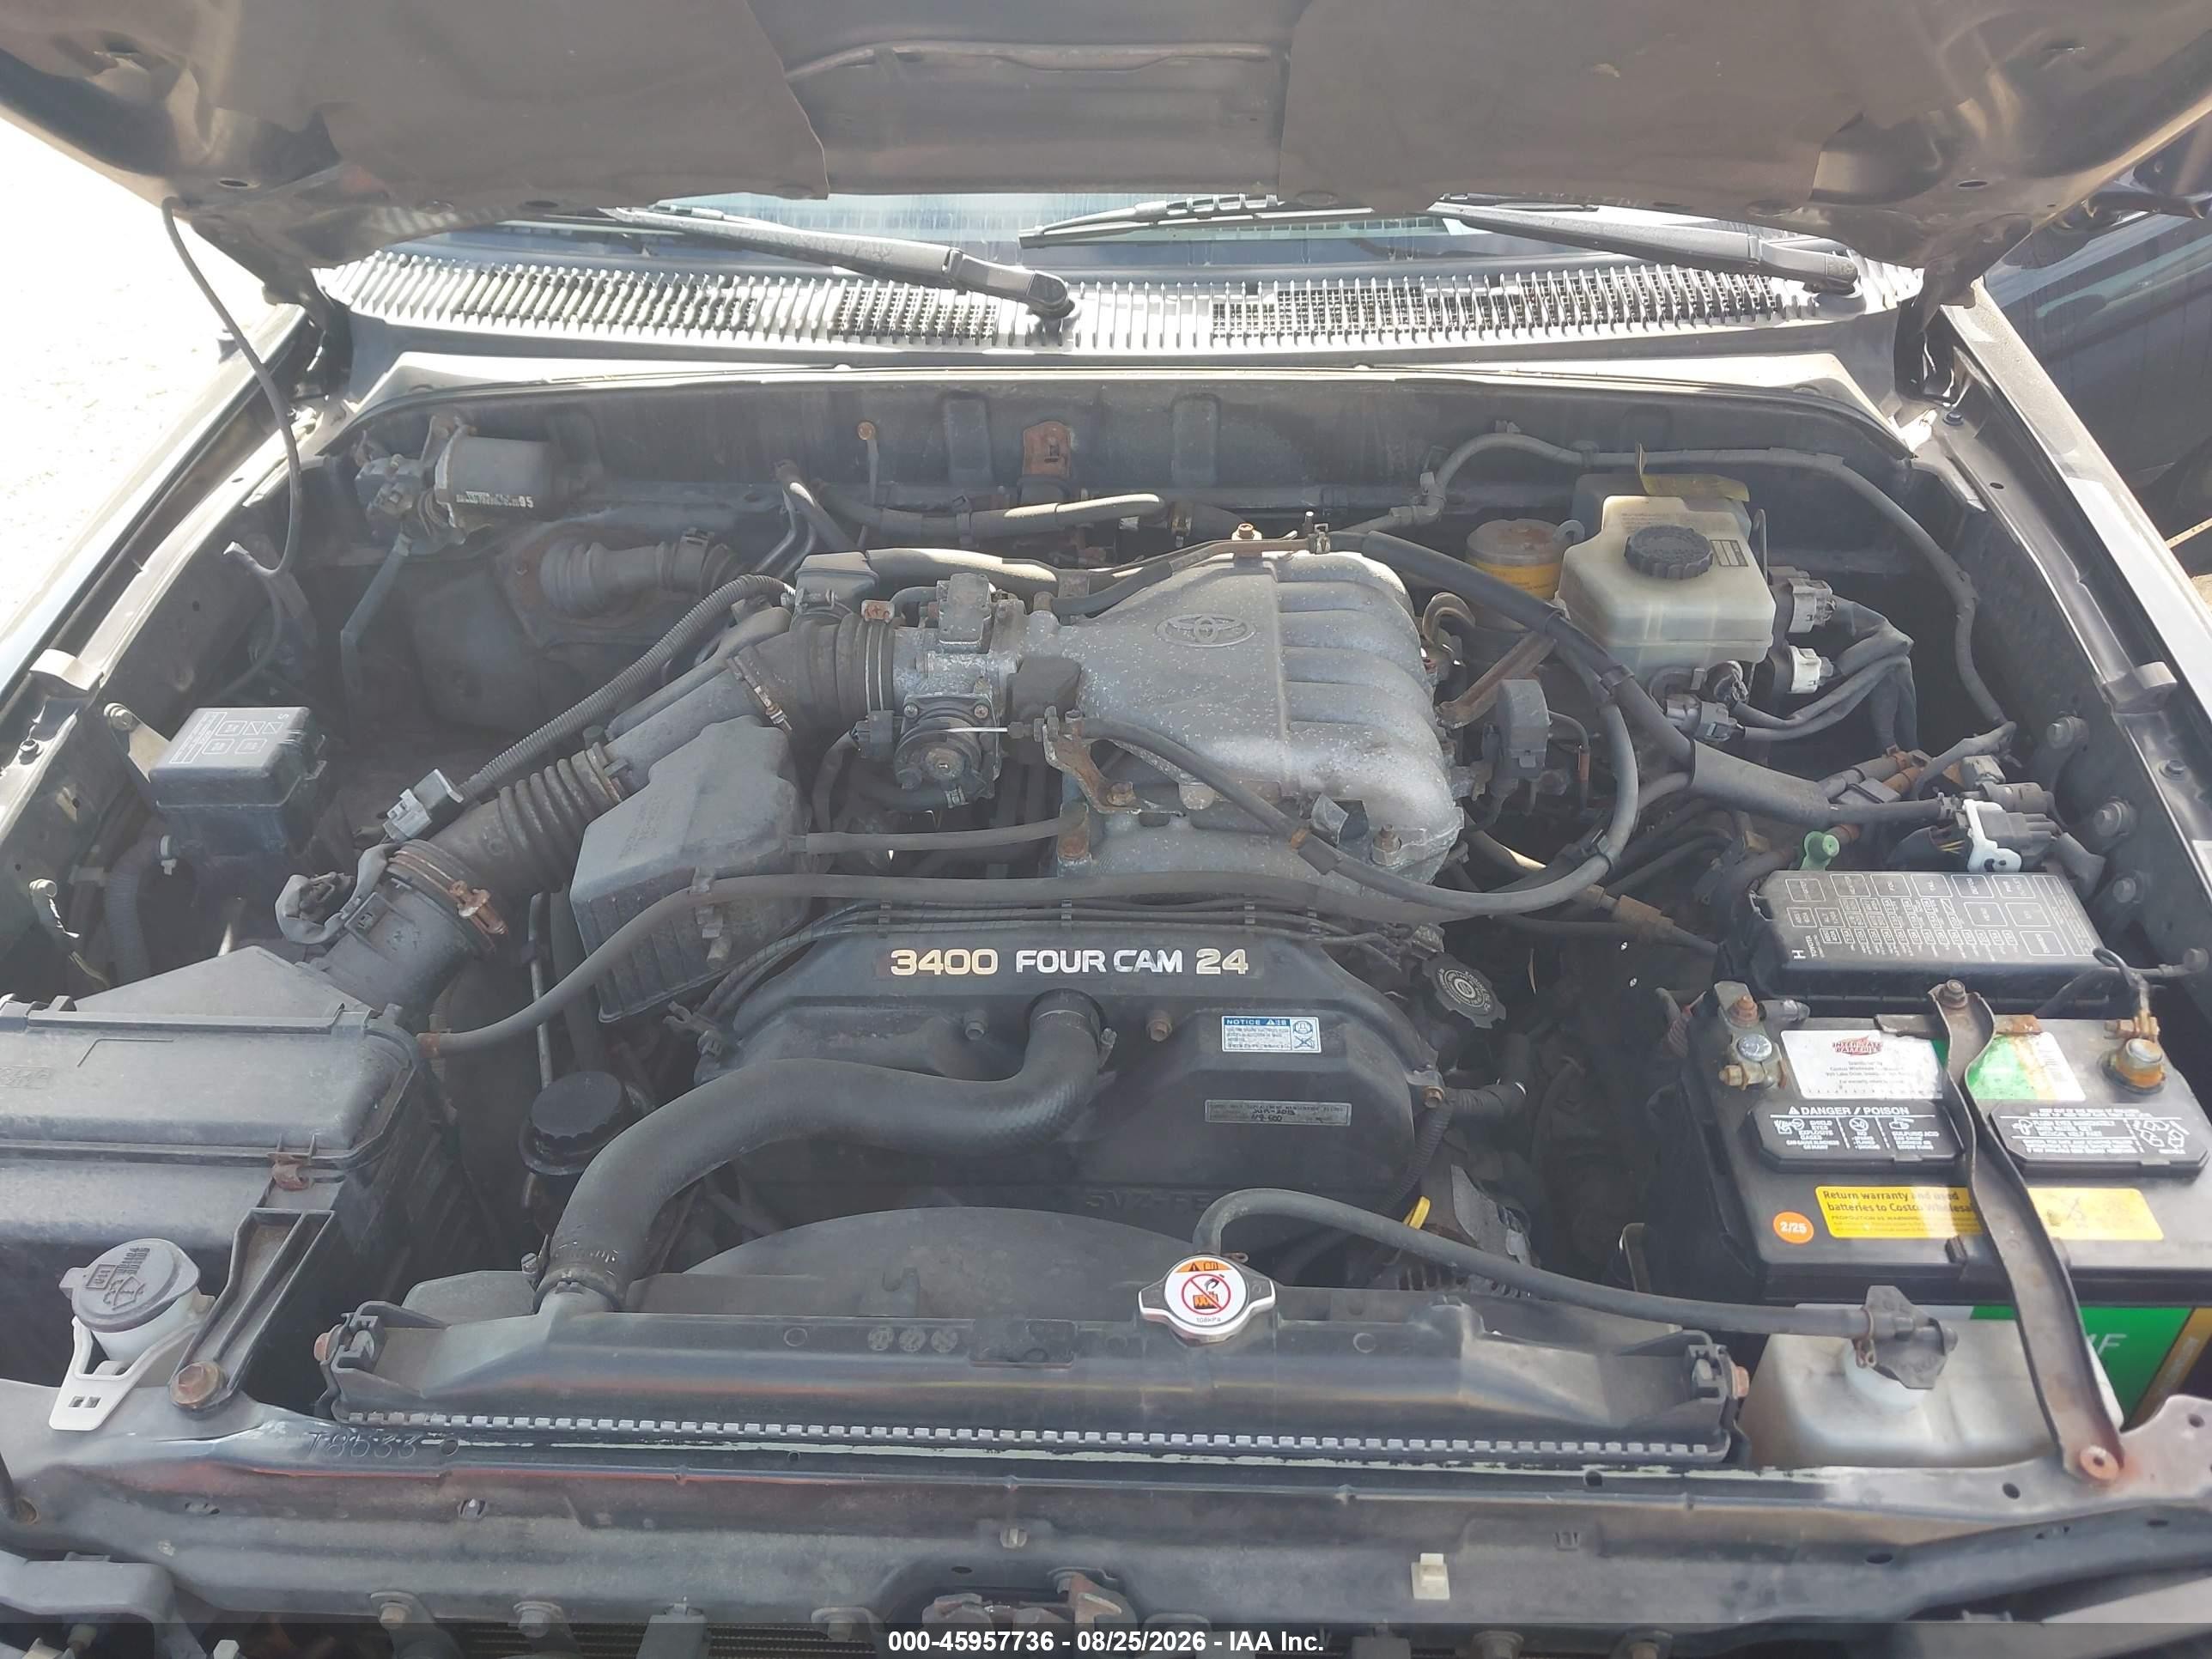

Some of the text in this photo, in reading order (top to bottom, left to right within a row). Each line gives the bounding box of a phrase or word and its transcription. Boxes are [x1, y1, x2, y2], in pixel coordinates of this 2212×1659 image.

[890, 949, 1249, 975] 3400 FOUR CAM 24
[1800, 1106, 1851, 1115] DANGER
[1863, 1106, 1910, 1115] POISON
[1823, 1190, 1859, 1200] Return
[1862, 1191, 1909, 1202] warranty
[1933, 1190, 1960, 1200] used
[1827, 1202, 1875, 1212] batteries
[1876, 1203, 1887, 1212] to
[1889, 1203, 1924, 1213] Costco
[1779, 1221, 1808, 1234] 2/25
